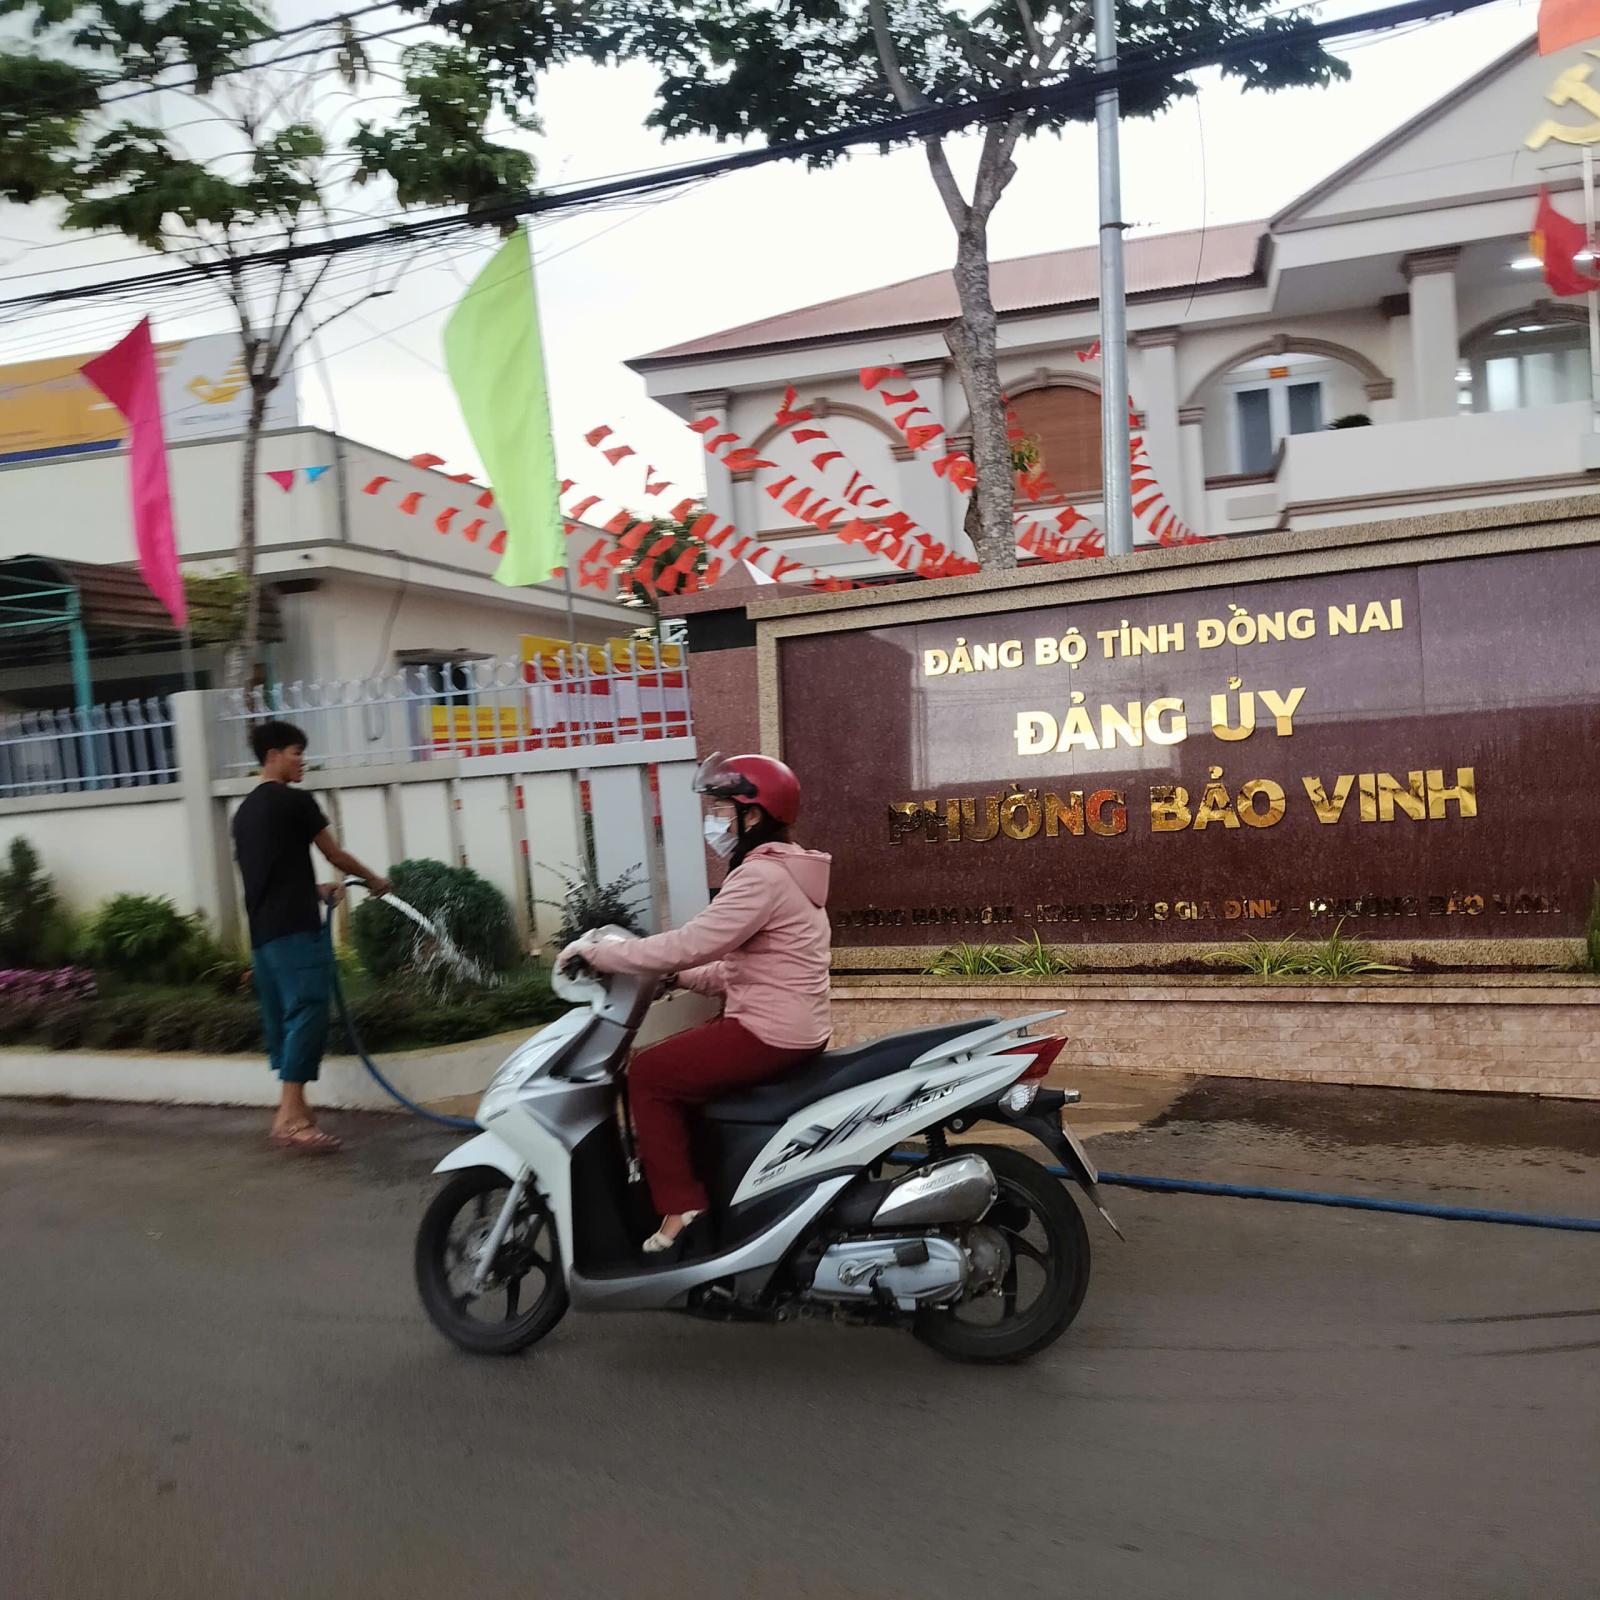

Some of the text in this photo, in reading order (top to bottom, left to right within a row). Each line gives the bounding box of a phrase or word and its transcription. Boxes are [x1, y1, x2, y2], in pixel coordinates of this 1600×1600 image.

[923, 598, 1403, 676] ĐẢNG BỘ TỈNH ĐỒNG NAI
[1013, 676, 1306, 756] ĐẢNG ỦY
[888, 766, 1478, 846] PHƯỜNG BẢO VINH
[1175, 900, 1216, 920] GIA
